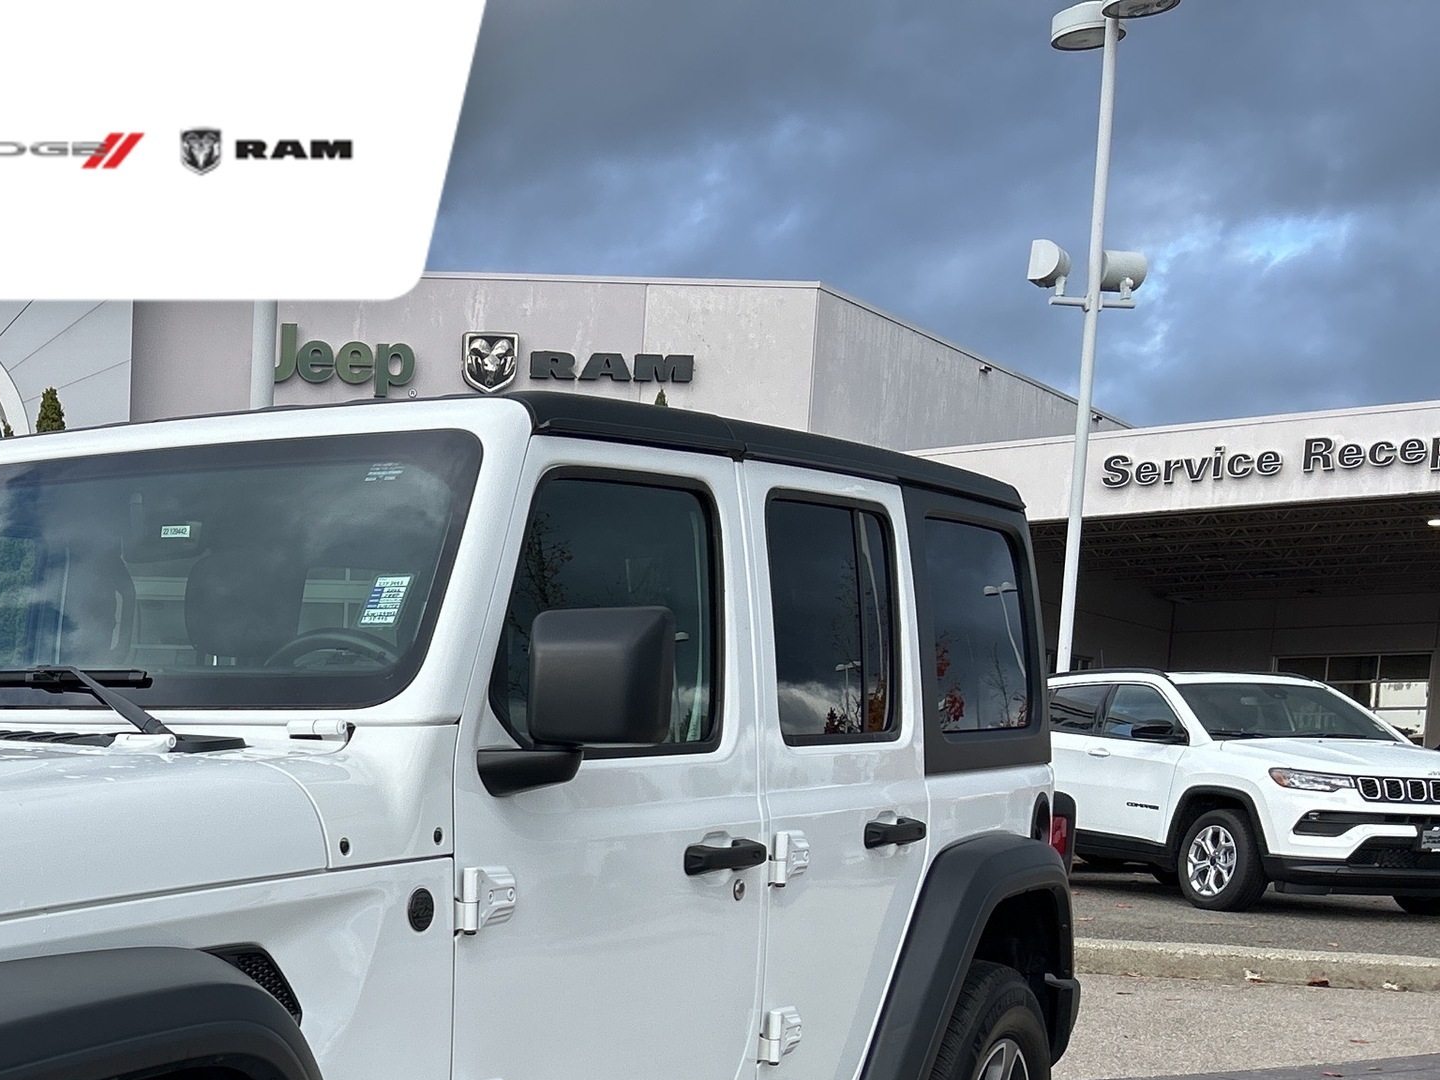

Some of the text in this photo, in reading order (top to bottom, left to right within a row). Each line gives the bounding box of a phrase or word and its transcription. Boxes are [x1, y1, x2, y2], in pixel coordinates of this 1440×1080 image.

[273, 323, 415, 398] Jeep
[529, 349, 695, 384] RAM
[1101, 446, 1284, 488] Service
